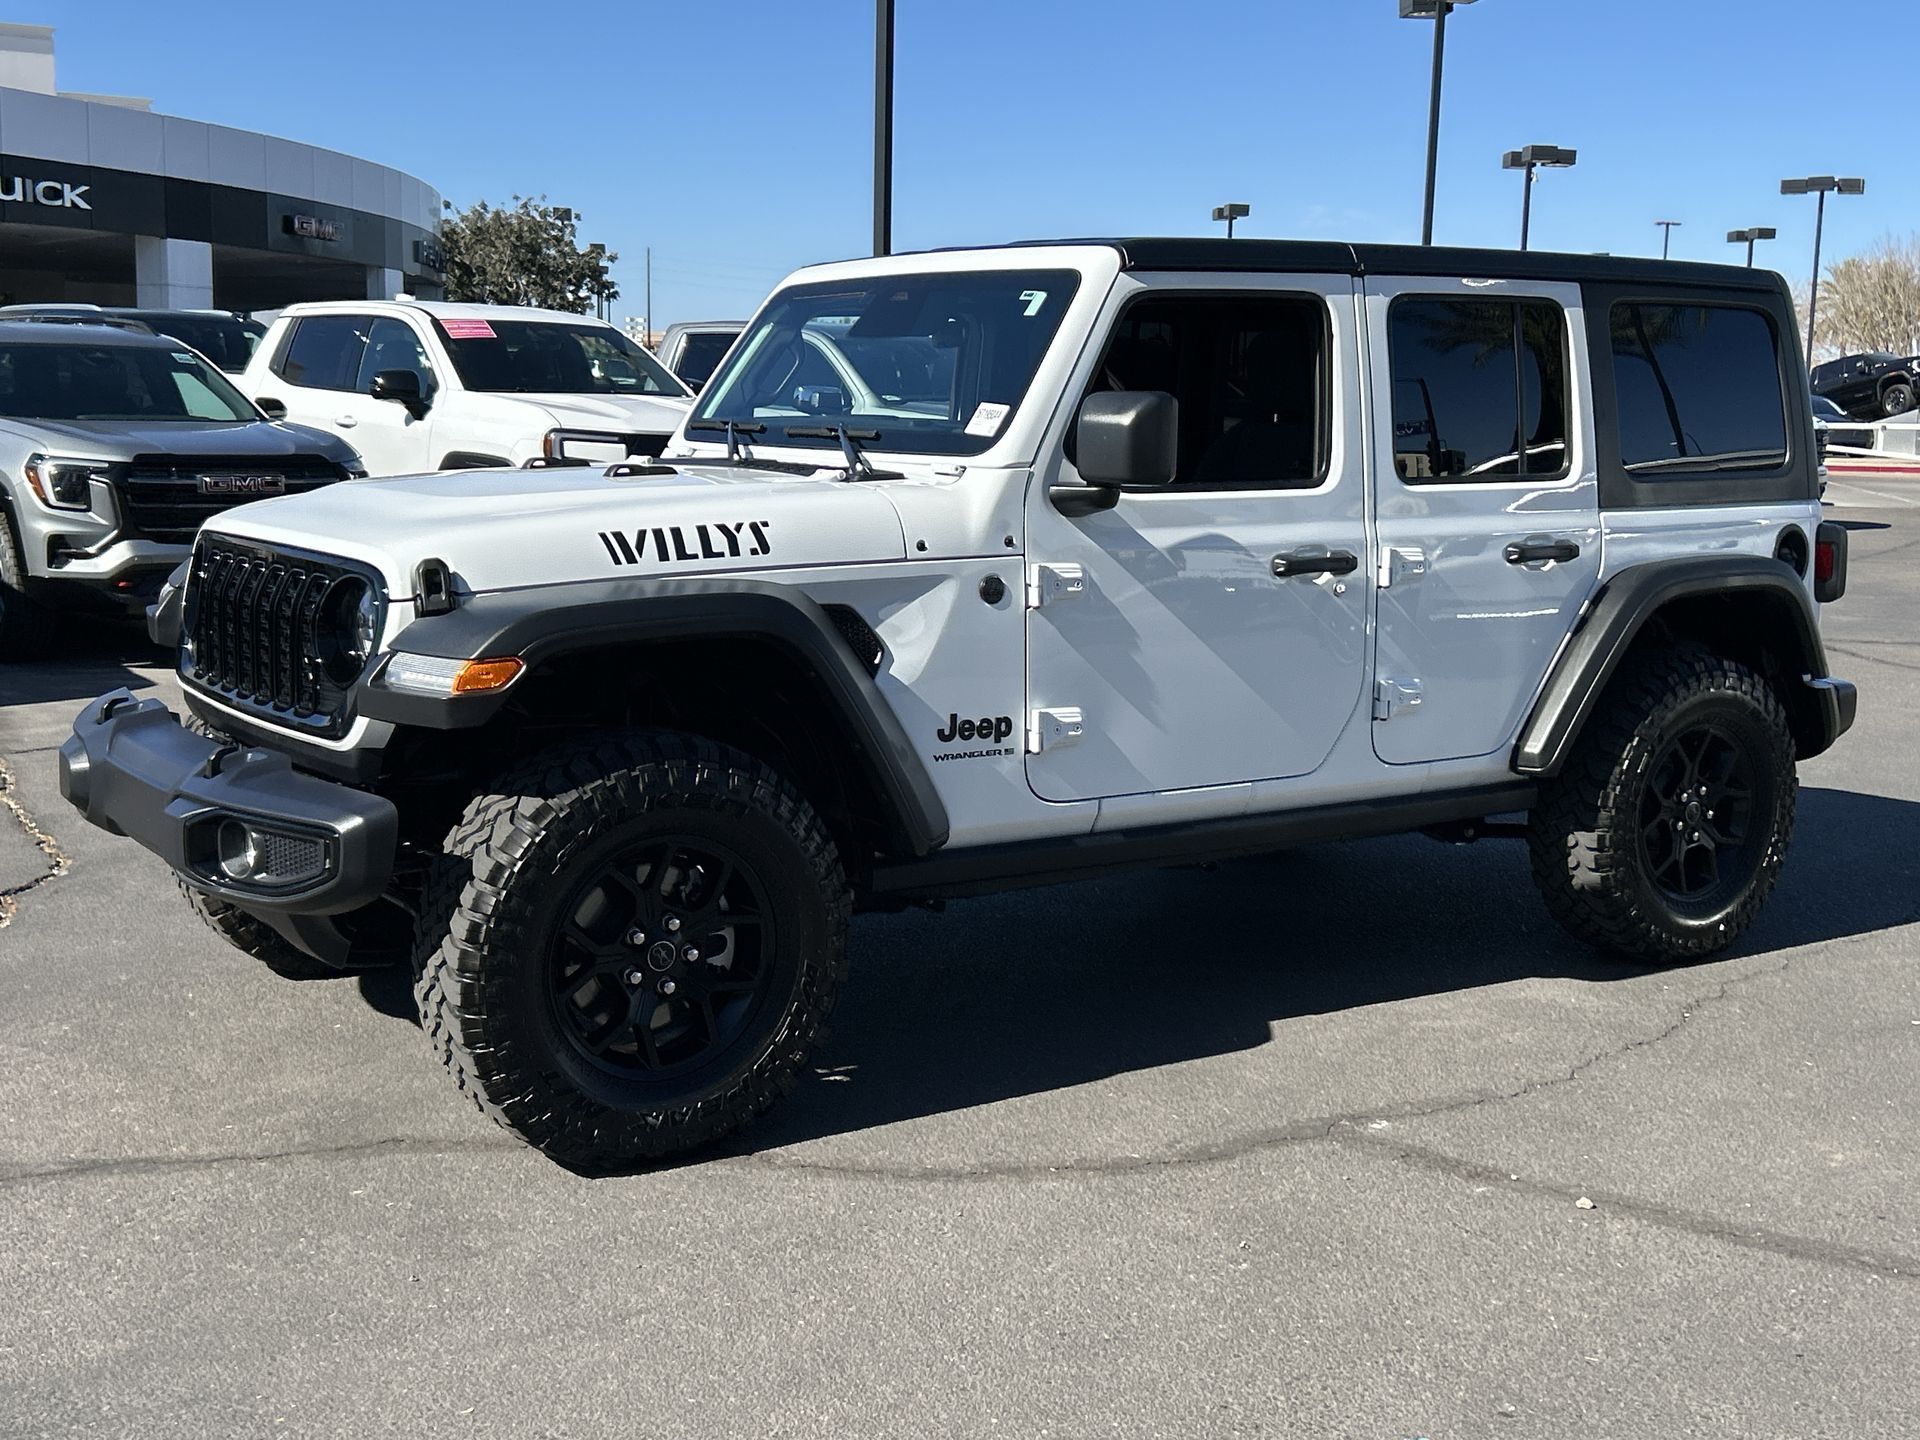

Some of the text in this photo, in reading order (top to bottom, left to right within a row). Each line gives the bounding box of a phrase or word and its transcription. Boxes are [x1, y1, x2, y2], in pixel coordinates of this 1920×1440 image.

[294, 214, 345, 241] GMC
[203, 475, 284, 493] GMC
[598, 520, 771, 566] WILLYS
[936, 713, 1013, 743] Jeep
[932, 748, 1002, 762] WRANGLER
